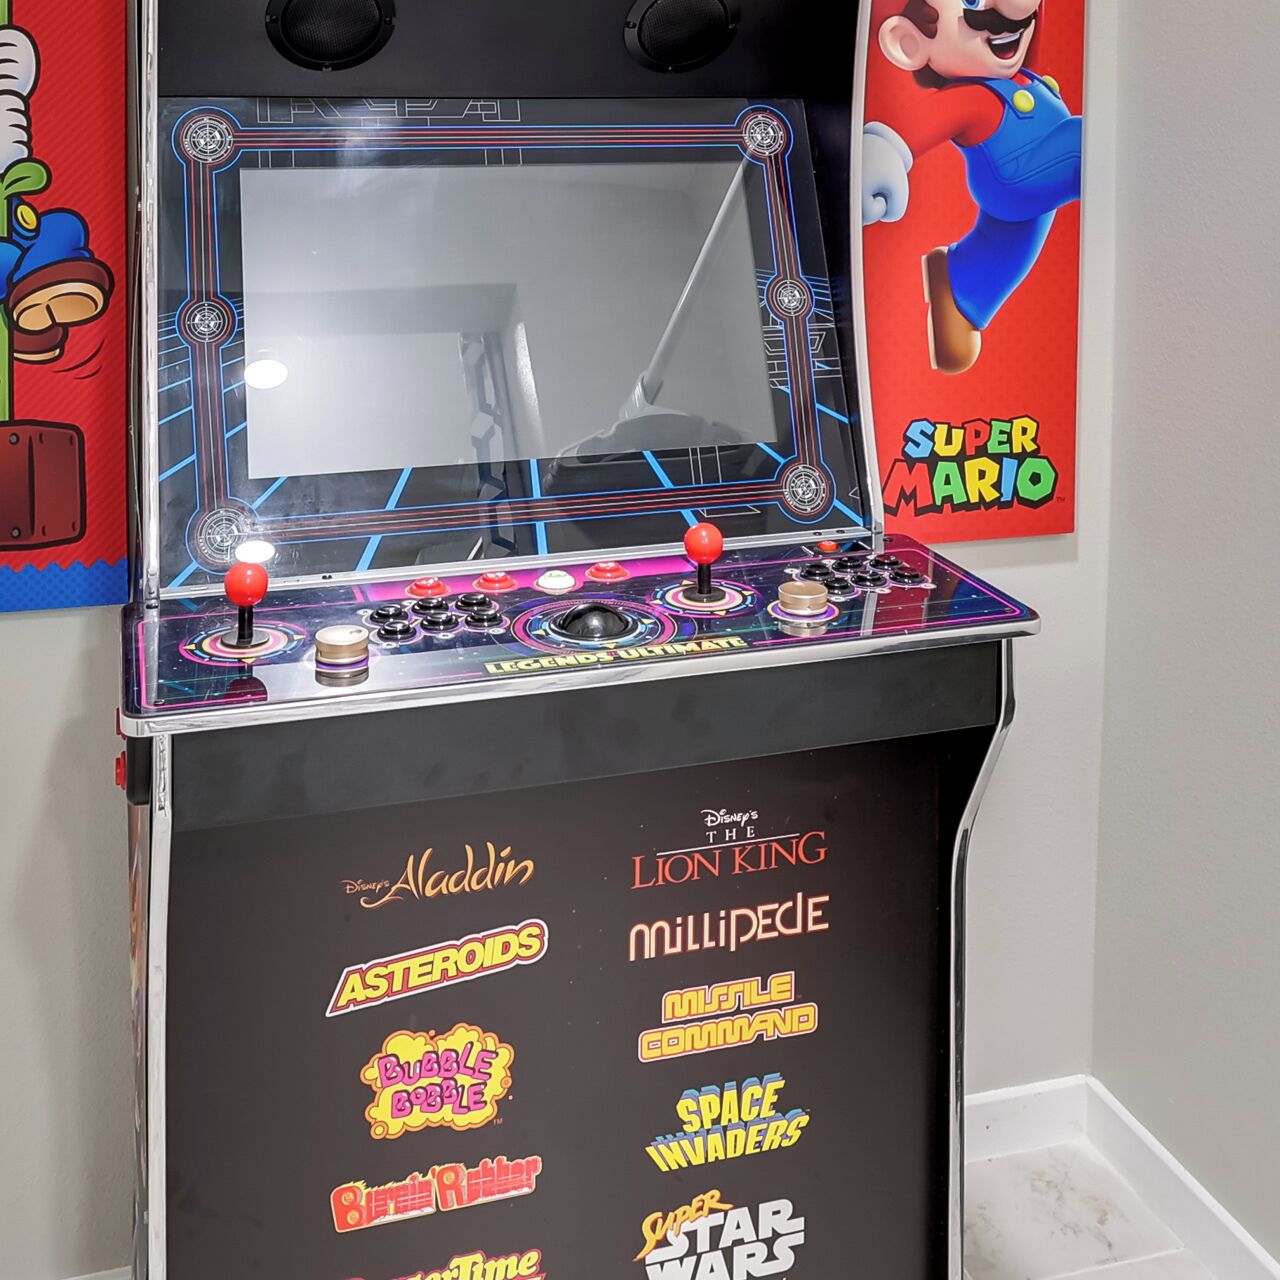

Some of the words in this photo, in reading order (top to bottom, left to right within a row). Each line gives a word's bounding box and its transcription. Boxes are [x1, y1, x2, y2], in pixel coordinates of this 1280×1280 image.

[903, 415, 1039, 459] SUPER
[883, 456, 1057, 508] MARIO
[484, 652, 613, 674] LEGENDS
[617, 636, 748, 661] ULTIMATE
[631, 850, 722, 890] LION
[732, 831, 828, 875] KING
[705, 826, 756, 844] THE
[360, 841, 535, 909] Aladdin
[334, 924, 543, 1009] ASTEROIDS
[663, 972, 795, 1022] MISSILE
[640, 1004, 817, 1061] COMMAND
[378, 1041, 498, 1089] BUBBLE
[391, 1077, 488, 1119] BOBBLE
[676, 1074, 786, 1133] SPACE
[645, 1113, 810, 1172] INVADERS
[632, 1189, 735, 1262] SUPER
[645, 1199, 806, 1265] STAR
